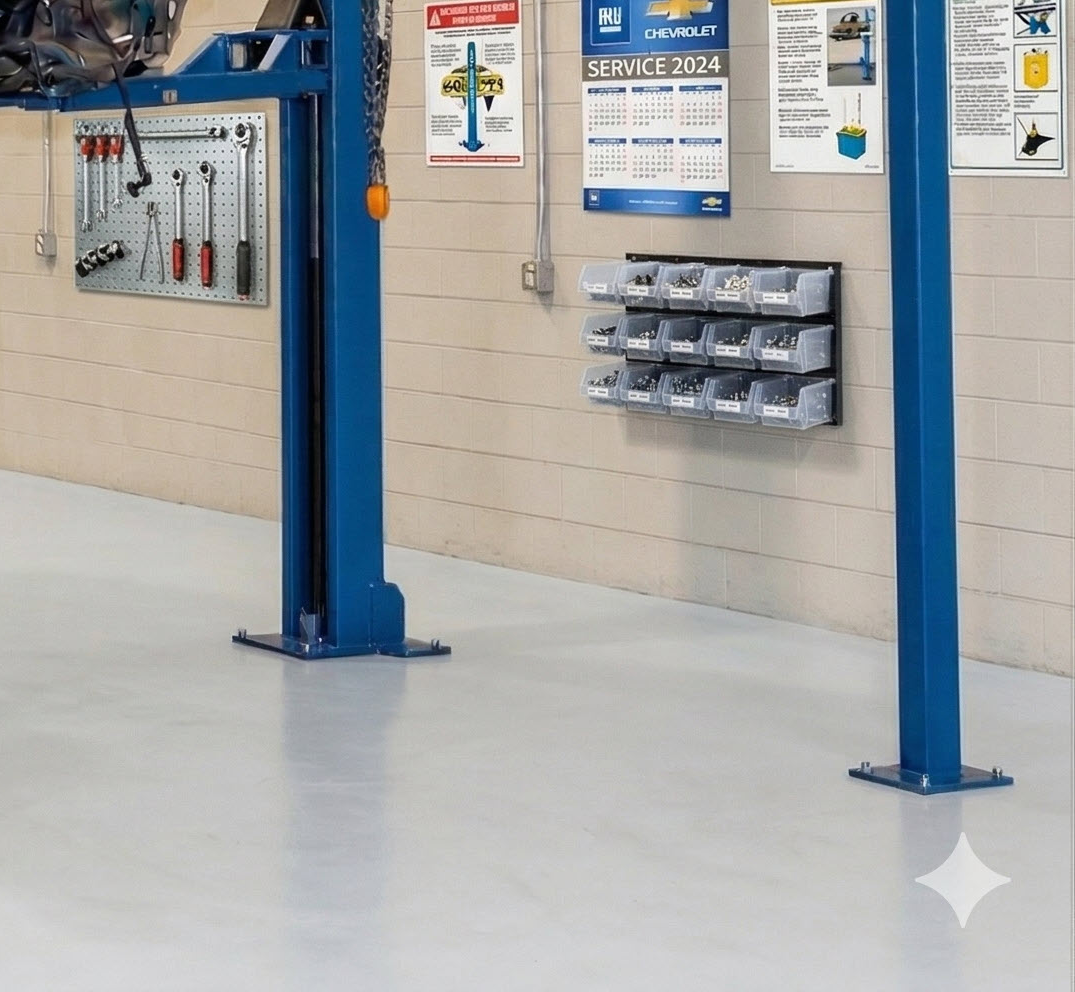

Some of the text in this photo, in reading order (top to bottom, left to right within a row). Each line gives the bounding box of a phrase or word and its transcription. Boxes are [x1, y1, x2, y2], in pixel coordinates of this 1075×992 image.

[644, 25, 717, 39] CHEVROLET
[587, 55, 721, 77] SERVICE 2024
